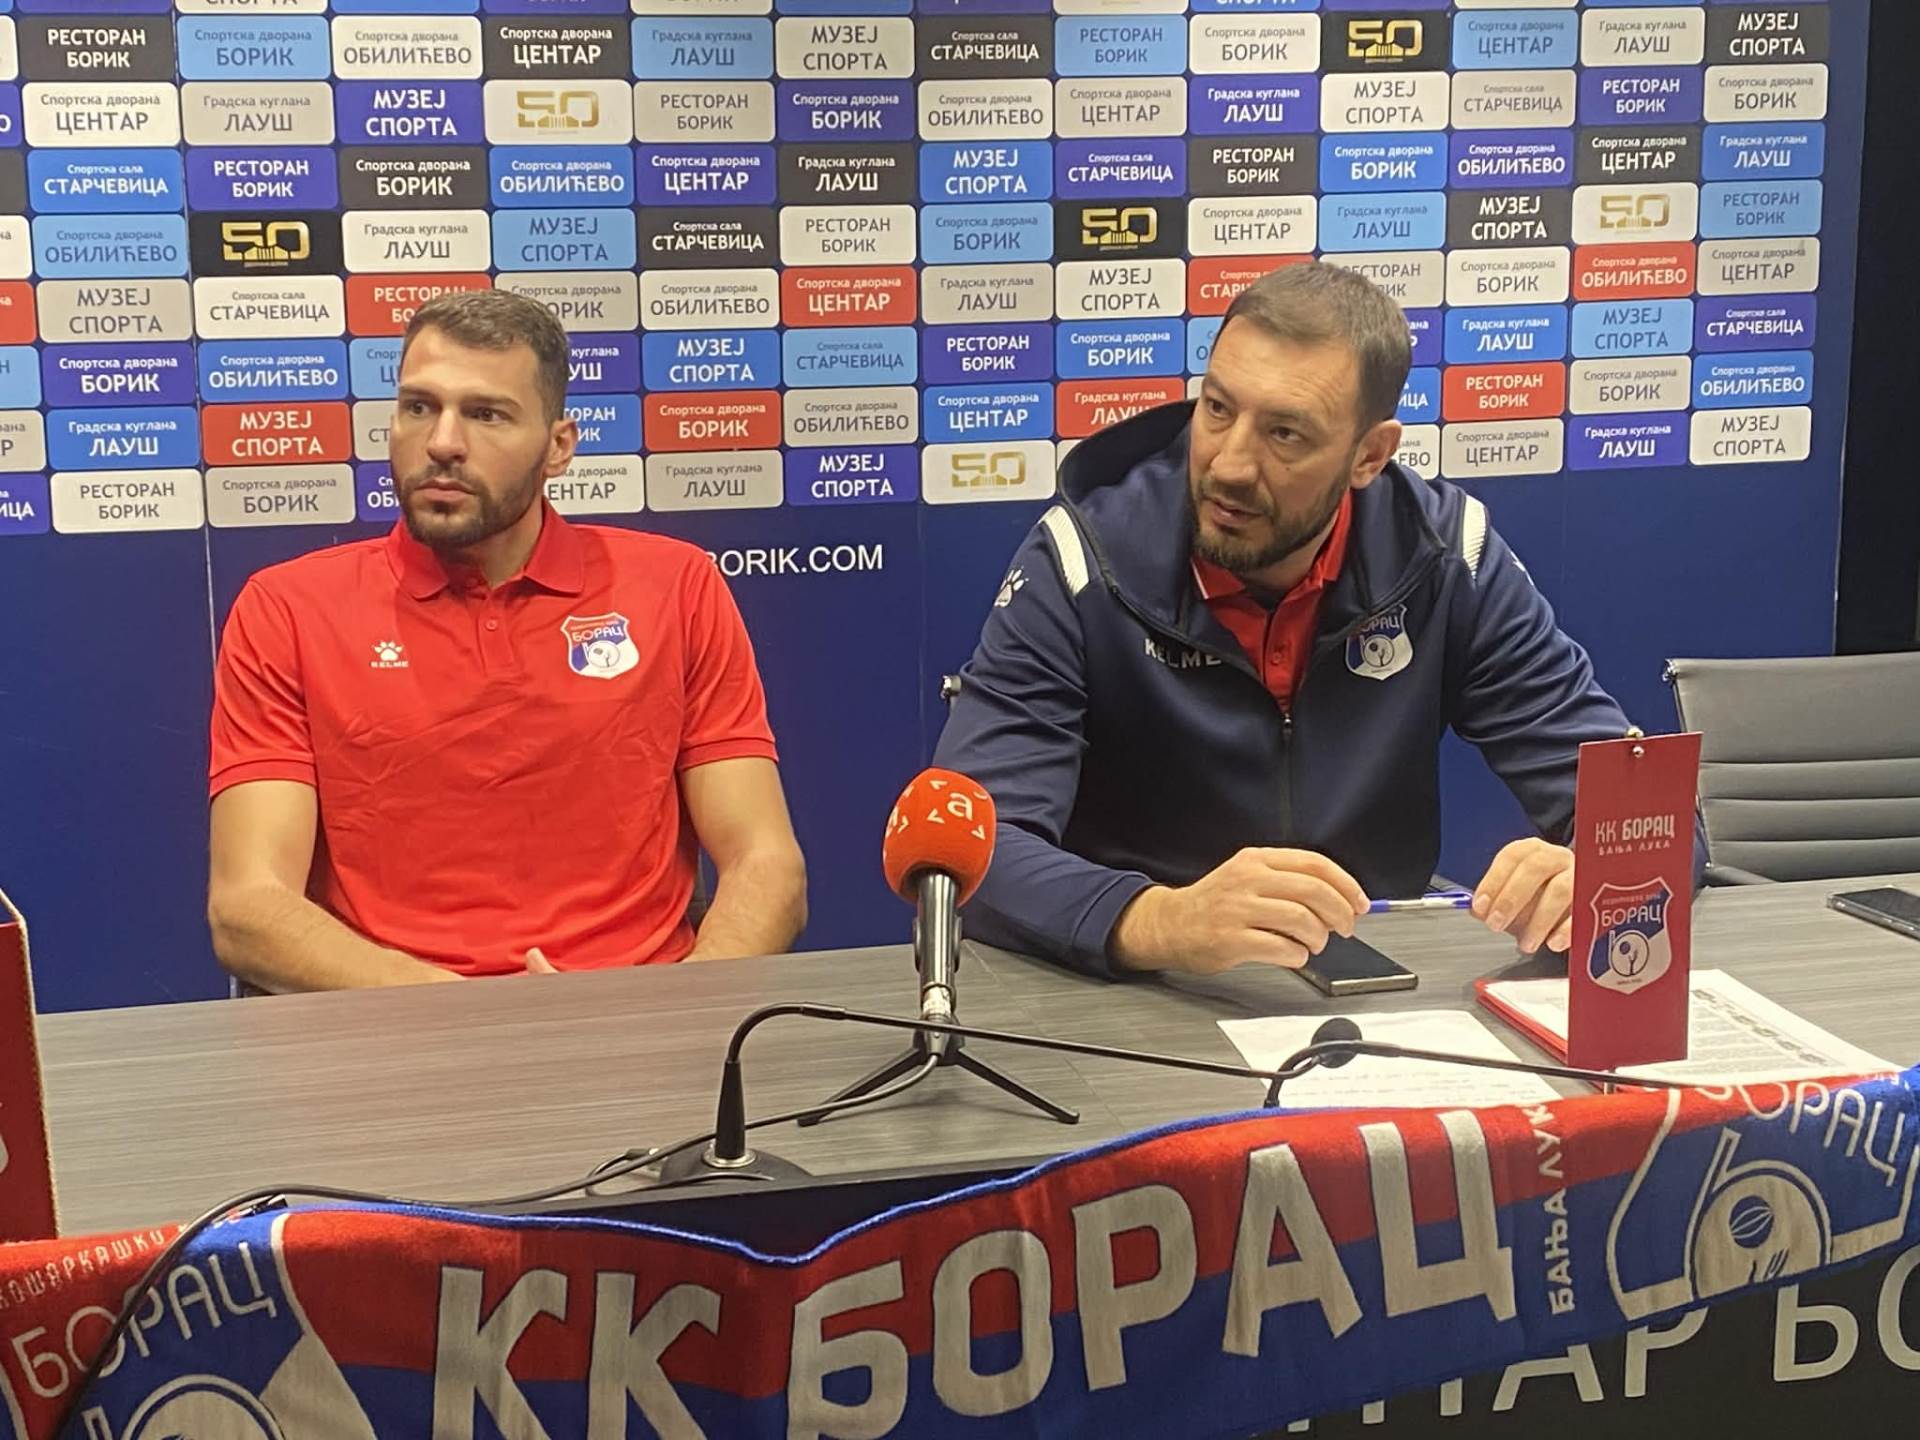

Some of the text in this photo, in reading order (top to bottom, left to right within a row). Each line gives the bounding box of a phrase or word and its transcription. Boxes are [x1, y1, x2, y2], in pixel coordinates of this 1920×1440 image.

[1738, 13, 1798, 30] МУЗЕЈ
[48, 29, 145, 45] РЕСТОРАН
[500, 27, 612, 41] Спортска дворана
[812, 26, 877, 43] МУЗЕЈ
[952, 31, 994, 42] Спортска
[931, 44, 1039, 62] СТАРЧЕВИЦА
[1222, 44, 1287, 60] БОРИК
[1614, 36, 1669, 53] ЛАУШ
[1730, 38, 1805, 56] СПОРТА
[67, 52, 130, 67] БОРИК
[344, 47, 472, 64] ОБИЛИЋЕВО
[514, 45, 601, 67] ЦЕНТАР
[803, 53, 887, 70] СПОРТА
[1208, 88, 1300, 101] Градска куглана
[1354, 81, 1416, 98] МУЗЕЈ
[1603, 79, 1680, 94] РЕСТОРАН
[374, 90, 445, 109] МУЗЕЈ
[661, 94, 748, 108] РЕСТОРАН
[1464, 97, 1563, 112] СТАРЧЕВИЦА
[1616, 99, 1665, 113] БОРИК
[1735, 92, 1796, 109] БОРИК
[812, 111, 881, 129] БОРИК
[928, 109, 1043, 126] ОБИЛИЋЕВО
[1082, 105, 1160, 126] ЦЕНТАР
[1224, 104, 1283, 122] ЛАУШ
[1346, 106, 1423, 124] СПОРТА
[56, 112, 148, 134] ЦЕНТАР
[224, 113, 292, 131] ЛАУШ
[366, 117, 457, 136] СПОРТА
[677, 116, 733, 129] БОРИК
[1469, 145, 1558, 157] Спортска дворана
[1592, 137, 1686, 149] Спортска дворана
[652, 155, 760, 168] Спортска дворана
[799, 157, 895, 170] Градска куглана
[954, 150, 1018, 168] МУЗЕЈ
[1088, 154, 1130, 163] Спортска
[1213, 148, 1294, 163] РЕСТОРАН
[1602, 152, 1675, 173] ЦЕНТАР
[1734, 150, 1790, 168] ЛАУШ
[67, 165, 116, 175] Спортска
[214, 160, 308, 176] РЕСТОРАН
[356, 160, 470, 173] Спортска дворана
[1068, 166, 1173, 182] СТАРЧЕВИЦА
[1352, 161, 1416, 179] БОРИК
[1458, 157, 1565, 175] ОБИЛИЋЕВО
[501, 175, 624, 192] ОБИЛИЋЕВО
[665, 172, 748, 194] ЦЕНТАР
[816, 173, 877, 191] ЛАУШ
[1228, 168, 1279, 183] БОРИК
[45, 178, 168, 196] СТАРЧЕВИЦА
[233, 182, 293, 197] БОРИК
[377, 177, 452, 195] БОРИК
[946, 175, 1027, 194] СПОРТА
[1480, 196, 1540, 215] МУЗЕЈ
[673, 222, 744, 234] Спортска сала
[806, 218, 890, 232] РЕСТОРАН
[1215, 223, 1290, 244] ЦЕНТАР
[1472, 221, 1547, 240] СПОРТА
[384, 241, 450, 259] ЛАУШ
[652, 234, 764, 252] СТАРЧЕВИЦА
[822, 239, 875, 252] БОРИК
[1089, 268, 1151, 285] МУЗЕЈ
[1722, 263, 1794, 284] ЦЕНТАР
[1477, 276, 1538, 293] БОРИК
[77, 288, 150, 306] МУЗЕЈ
[809, 293, 890, 315] ЦЕНТАР
[958, 293, 1016, 310] ЛАУШ
[1081, 293, 1160, 311] СПОРТА
[210, 305, 330, 322] СТАРЧЕВИЦА
[651, 298, 769, 315] ОБИЛИЋЕВО
[1726, 309, 1787, 320] Спортска сала
[69, 315, 163, 334] СПОРТА
[1463, 319, 1549, 331] Градска куглана
[1707, 318, 1803, 336] СТАРЧЕВИЦА
[678, 338, 744, 356] МУЗЕЈ
[947, 335, 1029, 351] РЕСТОРАН
[1071, 333, 1170, 344] Спортска дворана
[1477, 333, 1533, 351] ЛАУШ
[59, 358, 178, 371] Спортска дворана
[220, 356, 325, 367] Спортска дворана
[963, 356, 1015, 371] БОРИК
[1088, 348, 1153, 366] БОРИК
[209, 369, 338, 387] ОБИЛИЋЕВО
[670, 364, 754, 383] СПОРТА
[1712, 366, 1798, 377] Спортска дворана
[81, 374, 160, 393] БОРИК
[1701, 377, 1804, 396] ОБИЛИЋЕВО
[938, 394, 1039, 408] Спортска дворана
[1479, 394, 1528, 408] БОРИК
[1600, 384, 1660, 401] БОРИК
[69, 421, 176, 434] Градска куглана
[240, 411, 311, 429] МУЗЕЈ
[794, 415, 909, 433] ОБИЛИЋЕВО
[950, 409, 1028, 430] ЦЕНТАР
[1721, 415, 1779, 432] МУЗЕЈ
[679, 420, 748, 438] БОРИК
[1585, 426, 1671, 438] Градска куглана
[89, 437, 158, 456] ЛАУШ
[232, 437, 323, 456] СПОРТА
[1599, 439, 1655, 458] ЛАУШ
[1713, 439, 1786, 456] СПОРТА
[819, 454, 884, 472] МУЗЕЈ
[1466, 445, 1539, 466] ЦЕНТАР
[80, 482, 174, 498] РЕСТОРАН
[684, 480, 745, 497] ЛАУШ
[812, 479, 893, 498] СПОРТА
[99, 504, 159, 519] БОРИК
[244, 495, 319, 513] БОРИК
[572, 625, 624, 642] БОРАЦ
[1595, 814, 1675, 843] КК БОРАЦ
[1601, 904, 1662, 927] БОРАЦ
[1543, 1187, 1575, 1315] БАЊА
[432, 1266, 722, 1440] КК
[787, 1110, 1517, 1440] БОРАЦ
[11, 1241, 277, 1399] БОРАЦ
